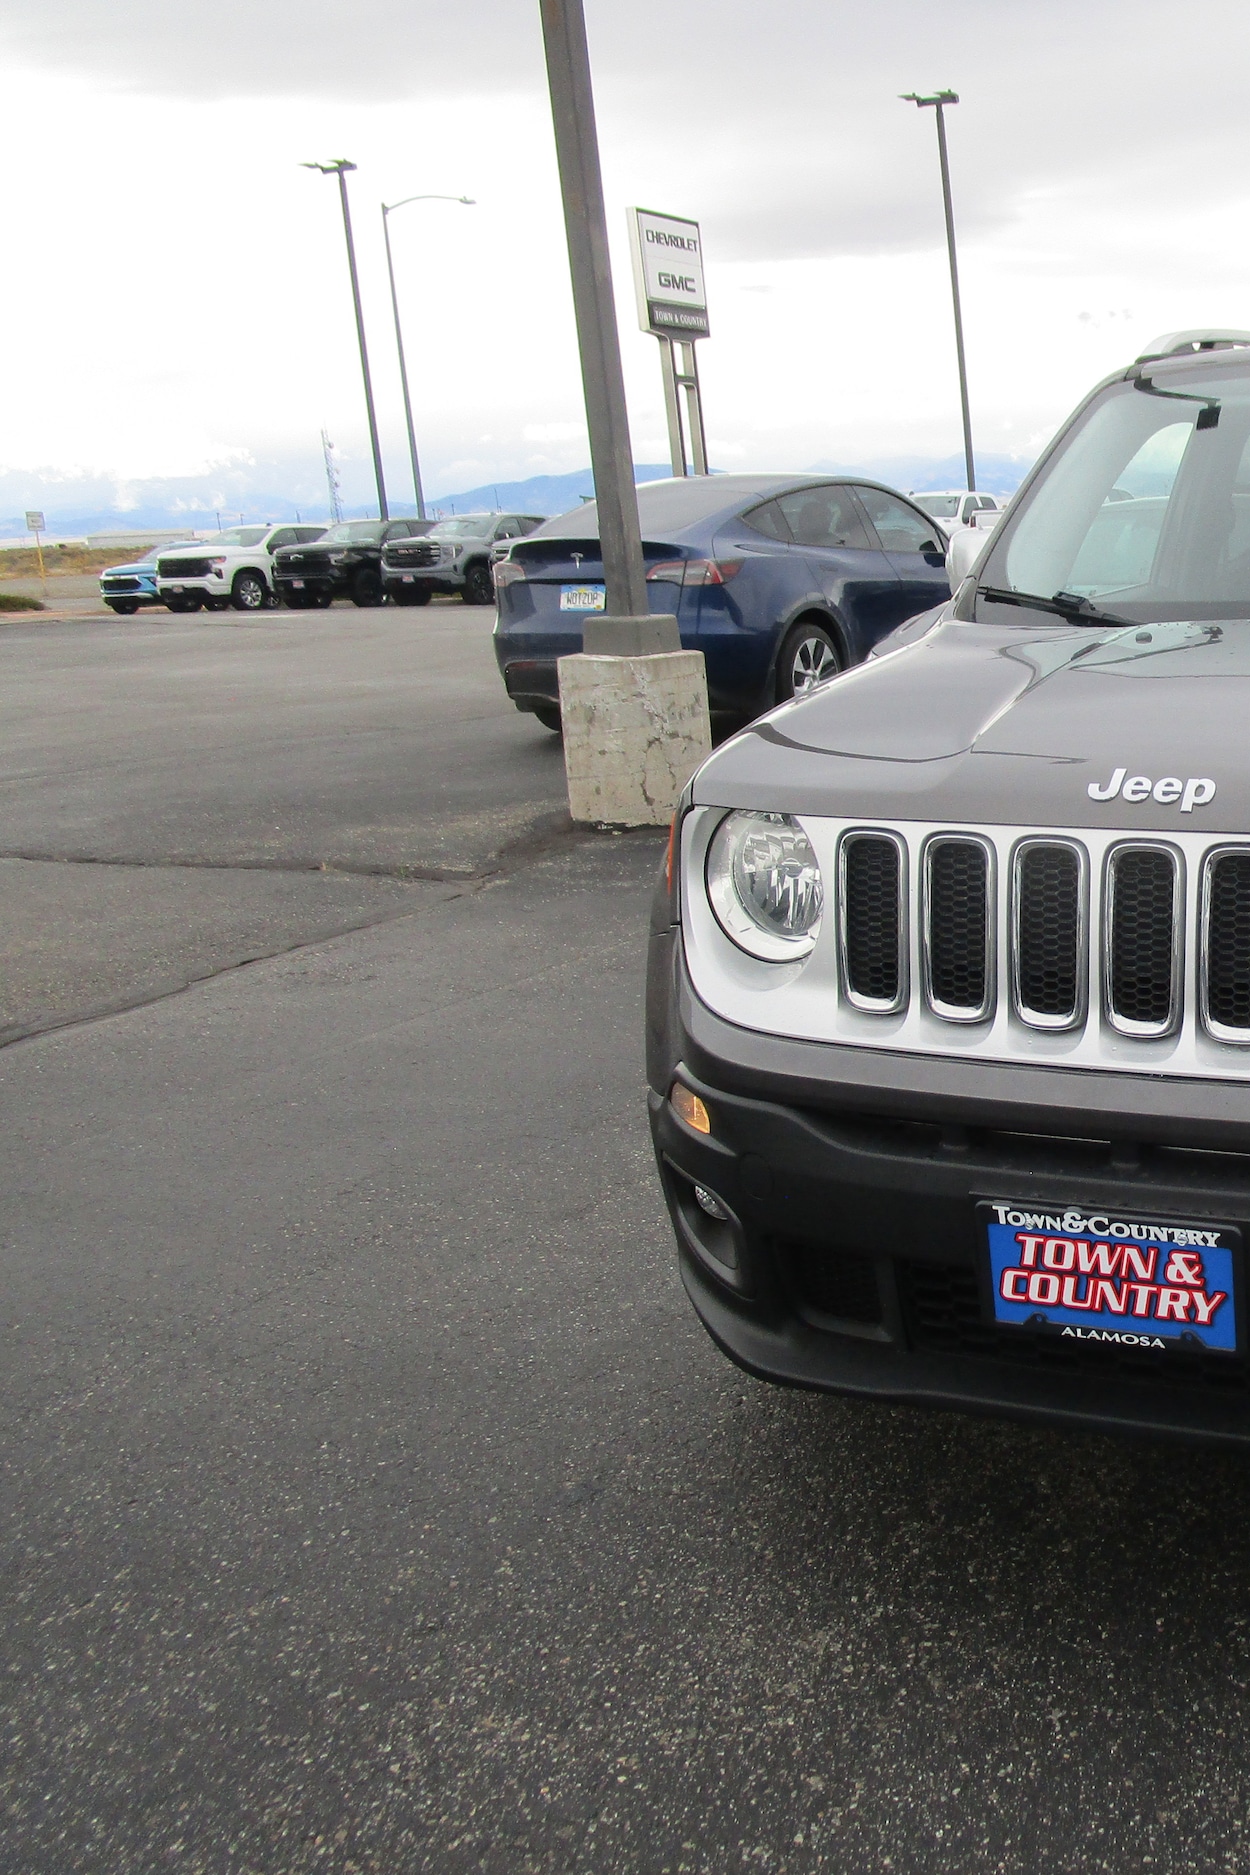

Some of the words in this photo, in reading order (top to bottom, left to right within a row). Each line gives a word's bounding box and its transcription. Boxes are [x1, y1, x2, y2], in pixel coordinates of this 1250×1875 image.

[645, 229, 698, 252] CHEVROLET
[658, 271, 696, 293] GMC
[655, 310, 673, 323] TOWN
[1087, 768, 1217, 814] Jeep
[1015, 1233, 1159, 1281] TOWN
[1164, 1250, 1205, 1287] &
[1000, 1268, 1226, 1326] COUNTRY
[1061, 1326, 1166, 1349] ALAMOSA
